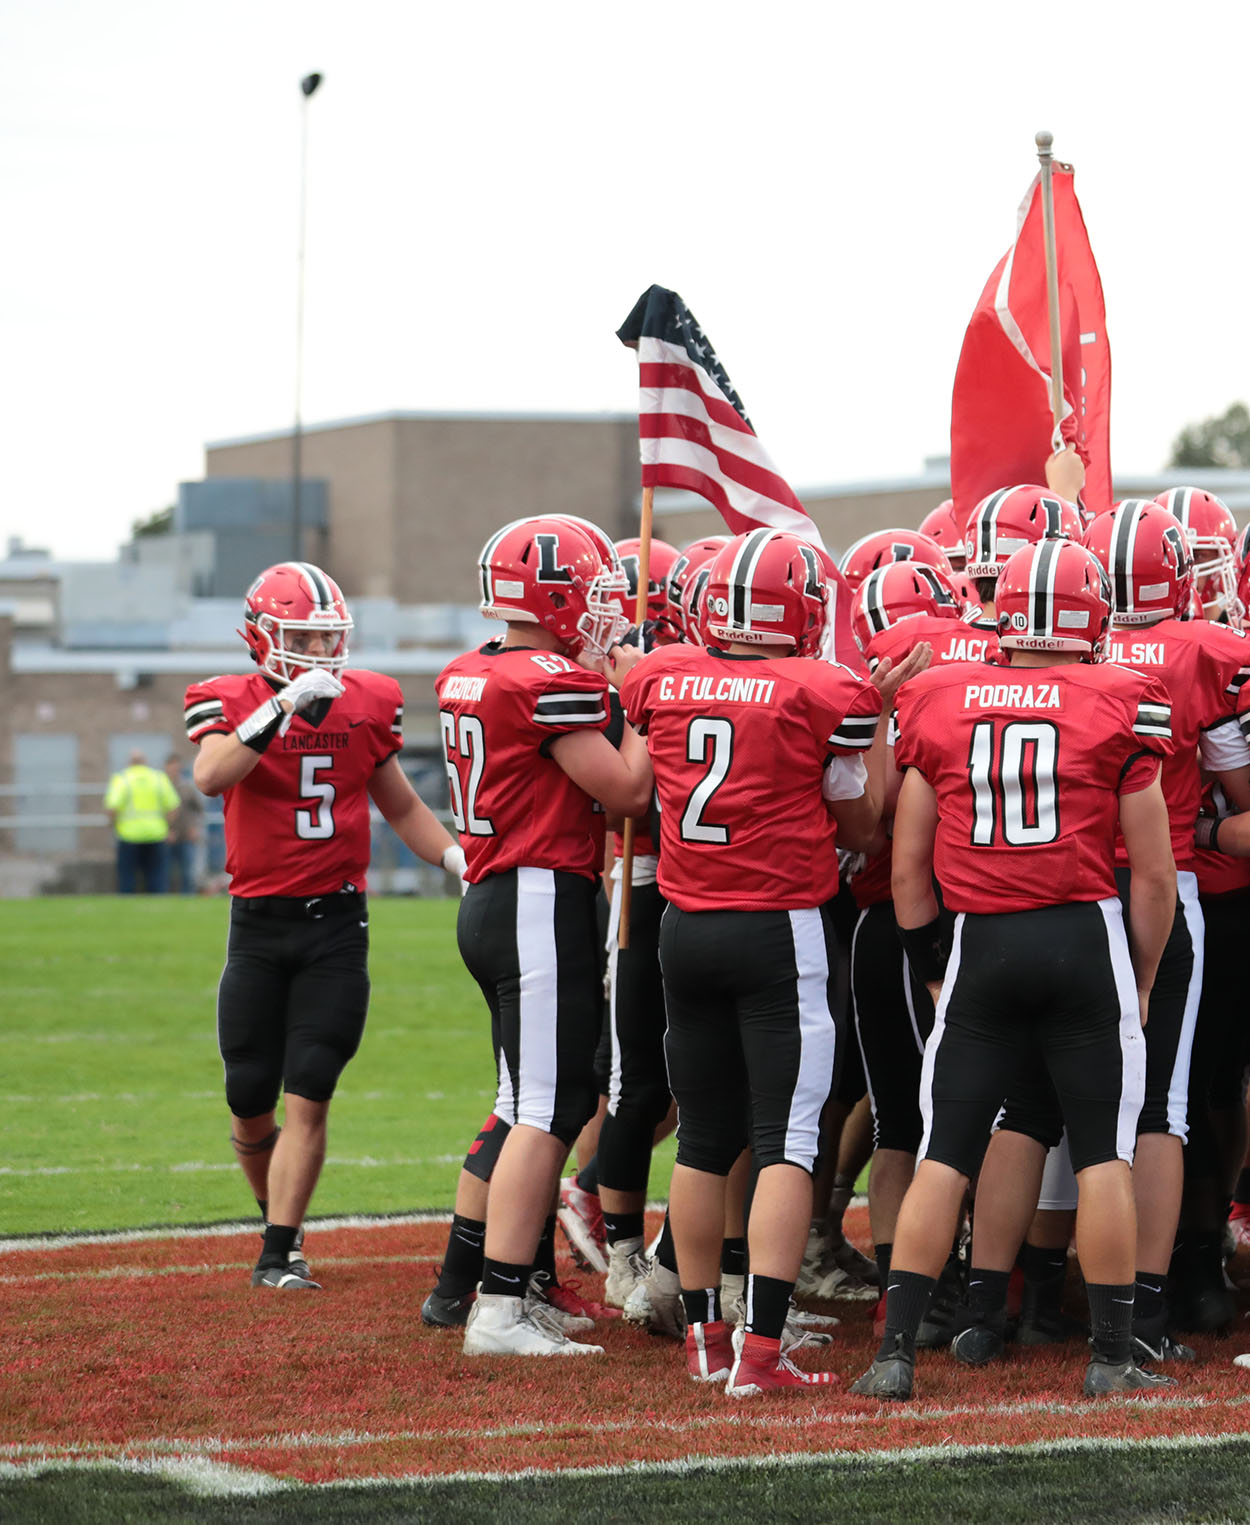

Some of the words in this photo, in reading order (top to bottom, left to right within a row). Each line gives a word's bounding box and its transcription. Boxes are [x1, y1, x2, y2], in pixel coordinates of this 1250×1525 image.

[535, 533, 577, 584] L
[1014, 615, 1025, 628] 10
[717, 629, 763, 641] Riddell
[1016, 639, 1065, 649] Riddell
[530, 655, 576, 674] 62
[1105, 642, 1165, 665] ULSKI
[659, 676, 675, 701] G.
[679, 676, 775, 704] FULCINITI
[964, 684, 1061, 709] PODRAZA
[282, 732, 350, 752] LANCASTER
[439, 709, 498, 838] 62
[679, 715, 735, 845] 2
[966, 720, 1061, 847] 10
[294, 753, 336, 841] 5
